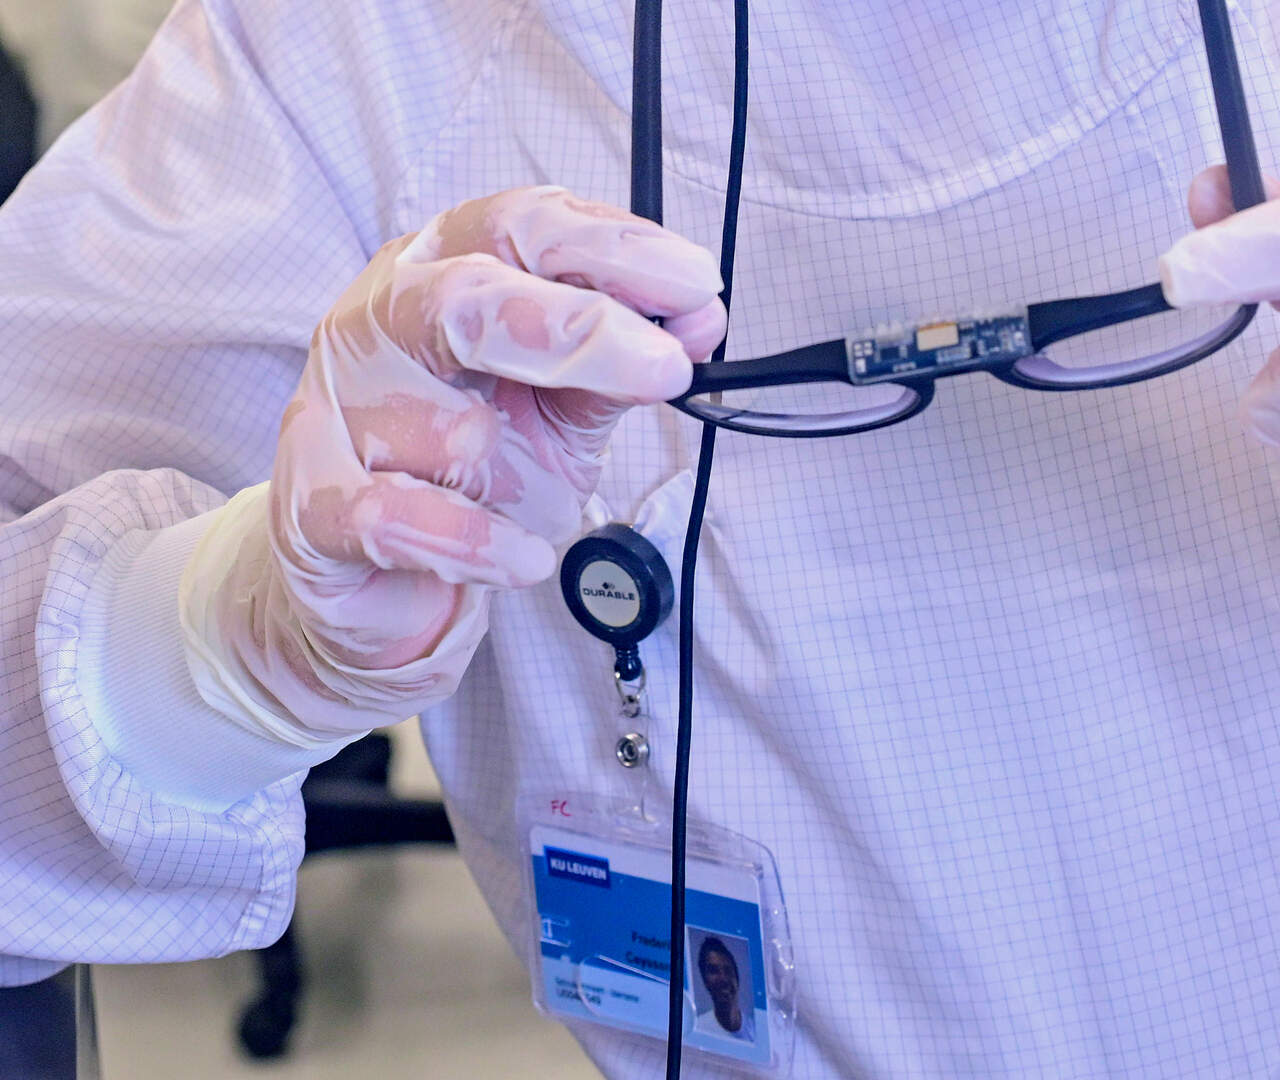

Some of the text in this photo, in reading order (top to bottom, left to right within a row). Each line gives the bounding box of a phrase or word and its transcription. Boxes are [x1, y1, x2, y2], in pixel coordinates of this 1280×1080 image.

[583, 587, 635, 601] DURABLE
[550, 799, 573, 817] FC
[550, 857, 607, 881] KU LEUVEN
